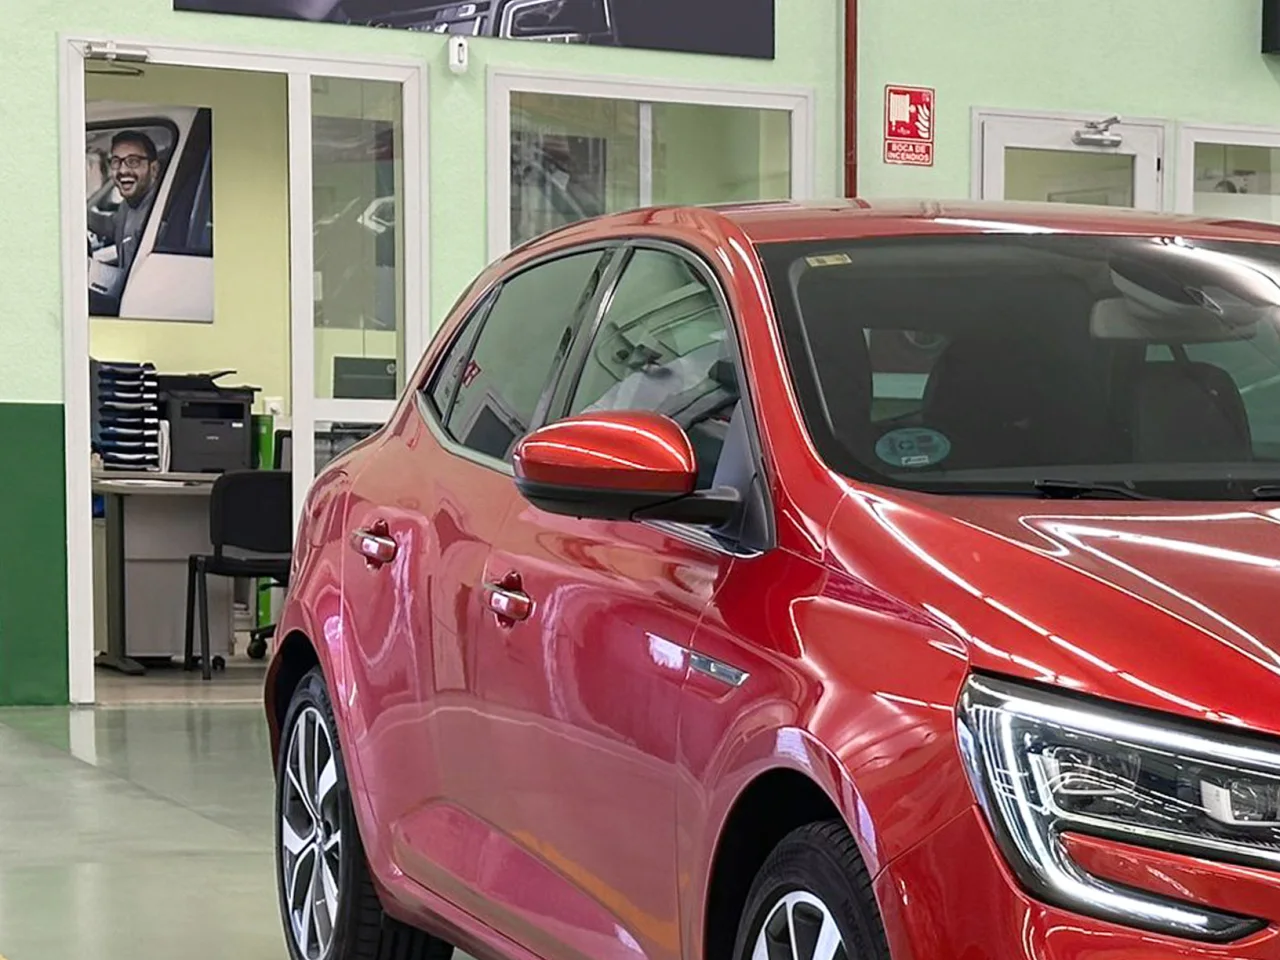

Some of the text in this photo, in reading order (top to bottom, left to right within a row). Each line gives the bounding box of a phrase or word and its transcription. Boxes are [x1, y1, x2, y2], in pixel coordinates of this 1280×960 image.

[891, 143, 926, 153] BOCA DE
[888, 151, 929, 162] INCENDIOS
